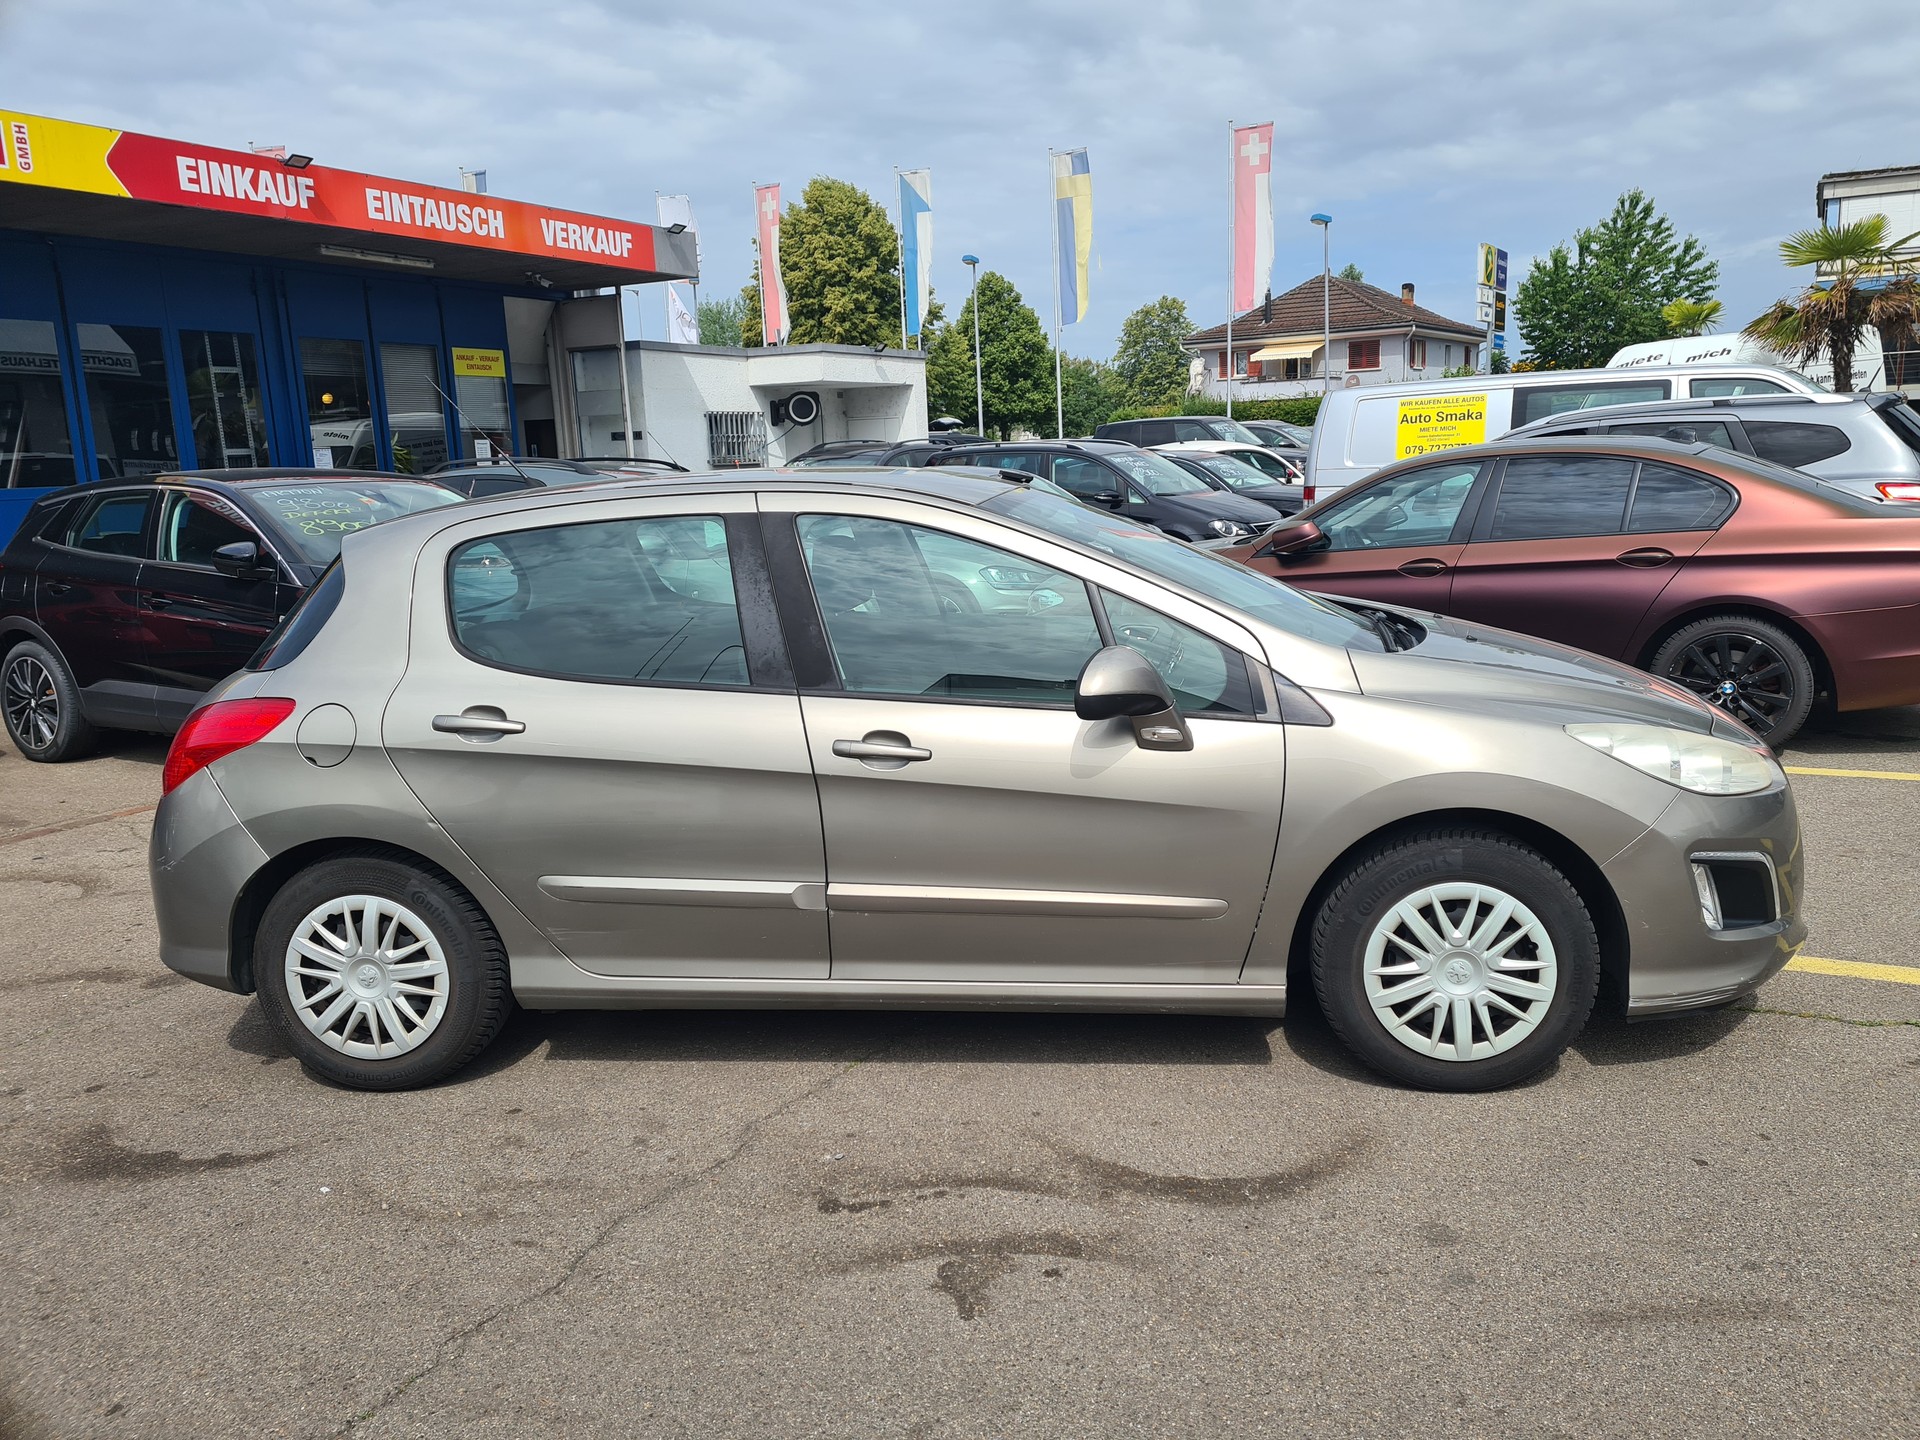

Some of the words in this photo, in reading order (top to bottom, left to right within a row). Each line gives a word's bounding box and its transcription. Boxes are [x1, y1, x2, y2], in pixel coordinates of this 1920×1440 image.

[13, 123, 31, 171] GMBH
[175, 155, 315, 209] EINKAUF
[365, 187, 505, 239] EINTAUSCH
[540, 217, 633, 258] VERKAUF
[466, 363, 493, 371] EINTAUSCH
[1685, 347, 1732, 363] mich
[1400, 413, 1432, 424] Auto
[1436, 409, 1483, 423] Smaka
[1414, 399, 1442, 407] KAUFEN
[1357, 858, 1438, 917] Continental
[411, 891, 469, 960] Continental
